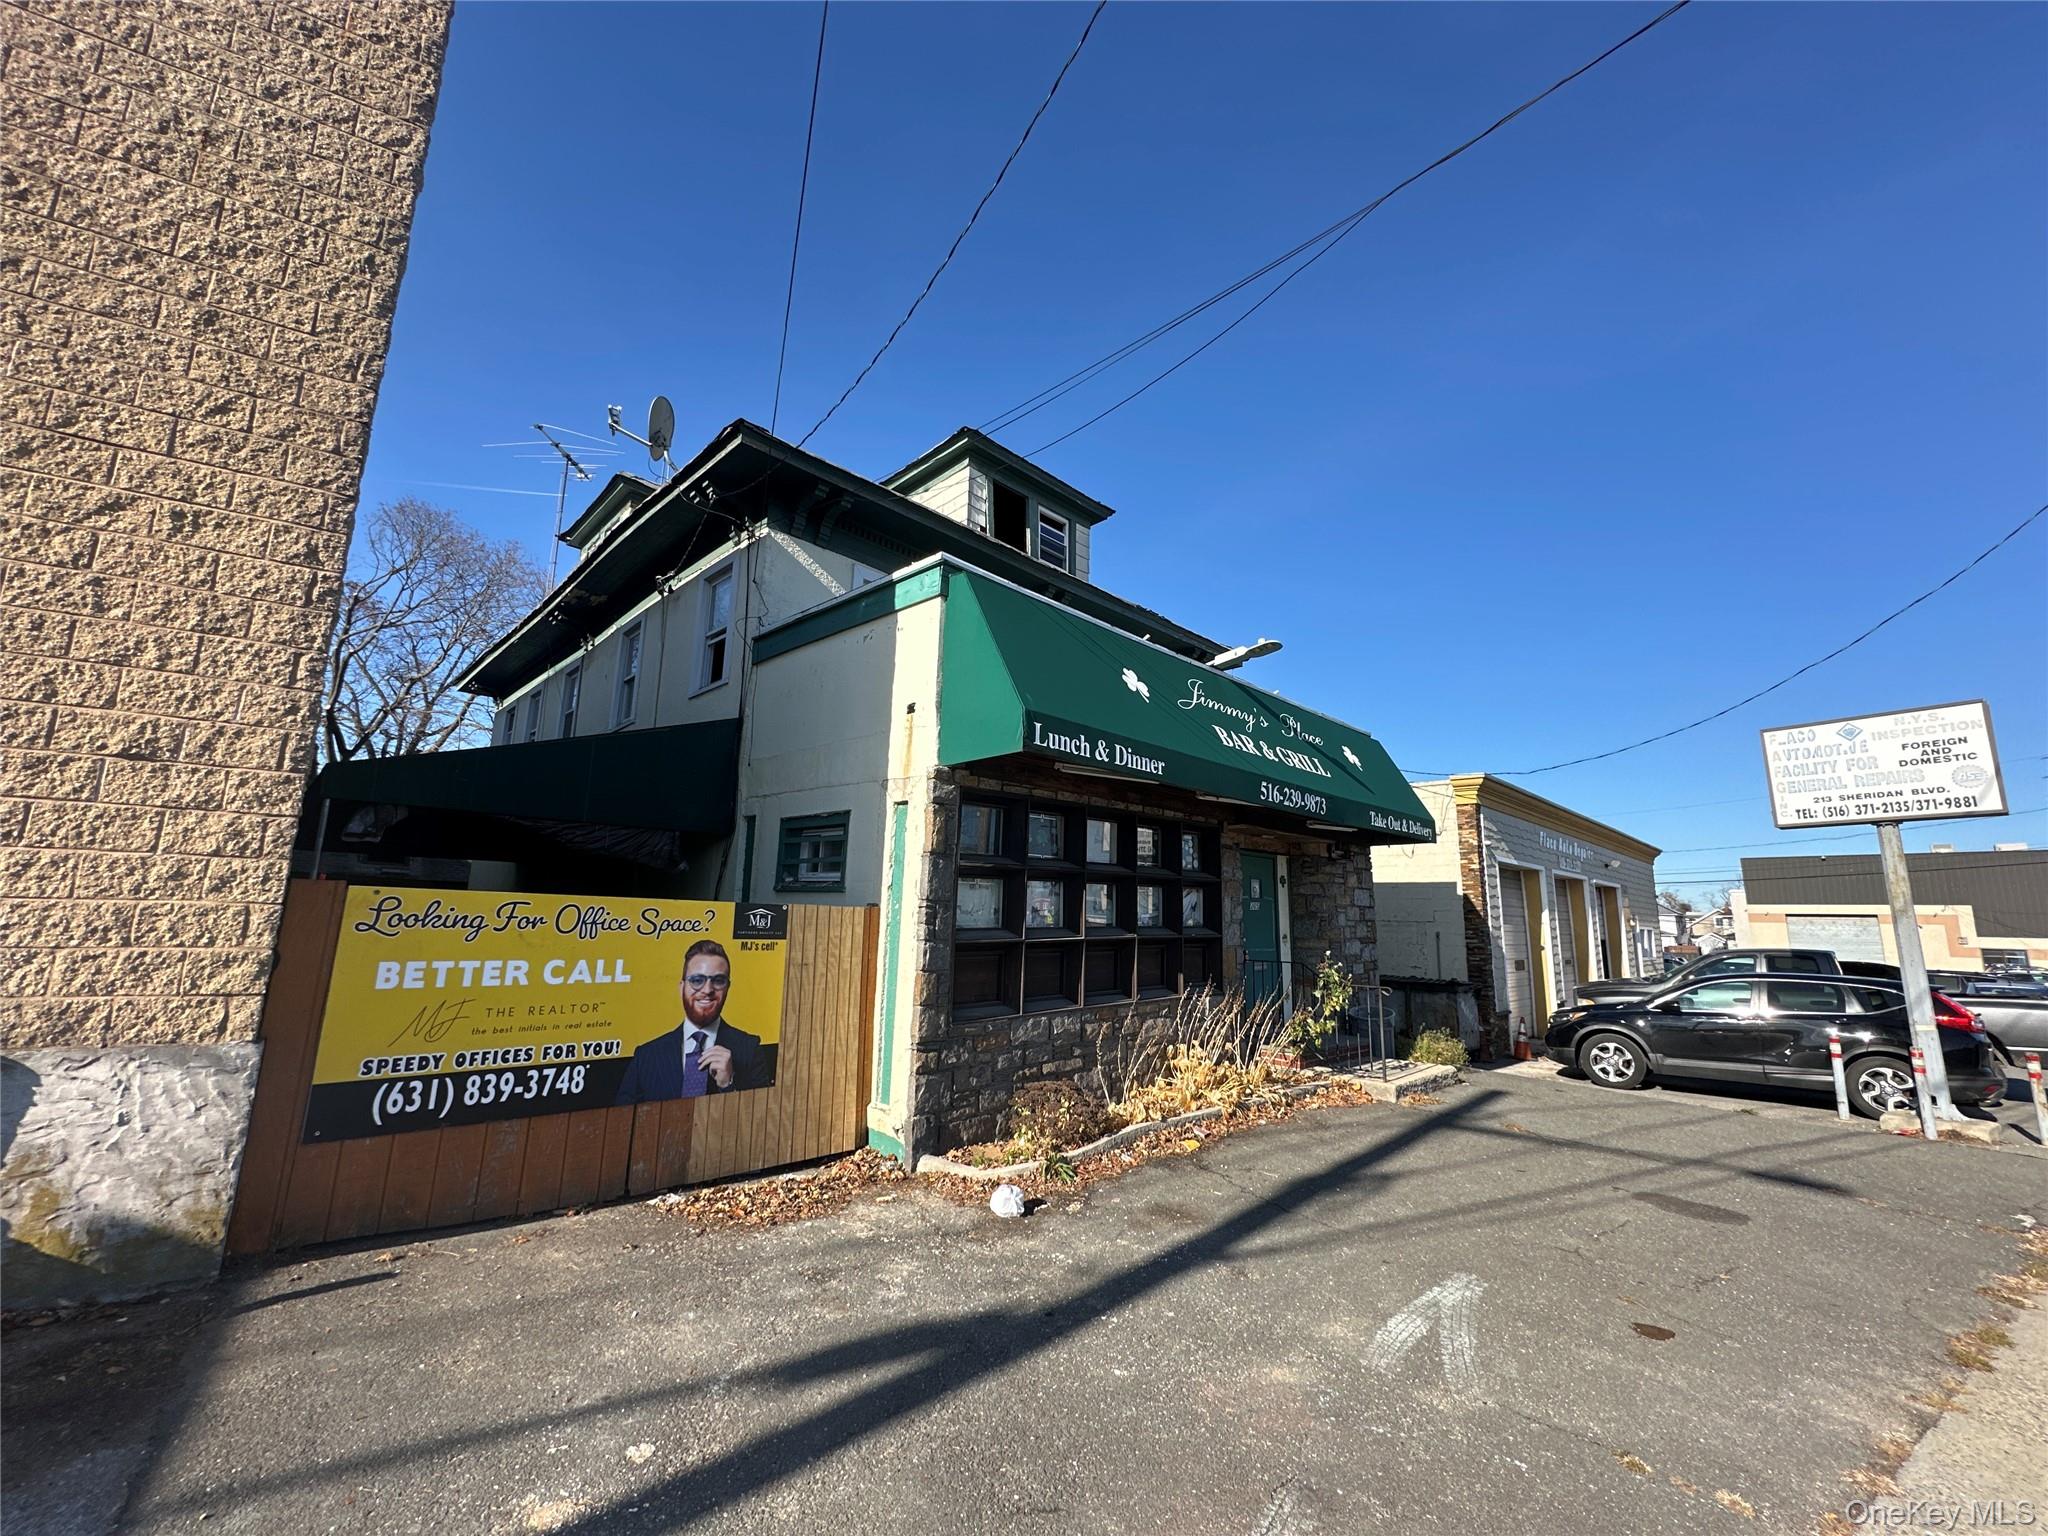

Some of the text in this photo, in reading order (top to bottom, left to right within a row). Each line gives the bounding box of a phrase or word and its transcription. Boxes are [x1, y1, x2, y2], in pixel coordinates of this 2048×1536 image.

[1178, 679, 1323, 746] Jimmy's Place
[1894, 713, 1944, 726] N.Y.S.
[1872, 720, 1983, 741] INSPECTION
[1033, 722, 1165, 775] Lunch & Dinner
[1212, 725, 1331, 777] BAR & GRILL
[1901, 737, 1968, 750] FOREIGN
[1921, 747, 1952, 756] AND
[1774, 756, 1878, 778] FACILITY FOR
[1899, 753, 1978, 767] DOMESTIC
[1776, 769, 1925, 793] GENERAL REPAIRS
[1260, 782, 1326, 815] 516-239-9873
[1839, 790, 1903, 801] SHERIDAN
[1911, 787, 1950, 795] BLVD.
[1795, 796, 1978, 820] TEL: (516) 371-2135/371-9881
[1369, 811, 1433, 840] Take Out & Delivery
[355, 896, 716, 942] Looking For Office Space?
[749, 915, 771, 928] M&J
[741, 942, 759, 950] MJ's
[374, 959, 631, 990] BETTER CALL
[486, 1007, 514, 1017] THE
[472, 1027, 486, 1035] the
[492, 1026, 512, 1034] best
[518, 1024, 547, 1032] initials
[586, 1020, 612, 1028] estate
[360, 1041, 621, 1077] SPEEDY OFFICES FOR YOU!
[372, 1079, 454, 1125] (631)
